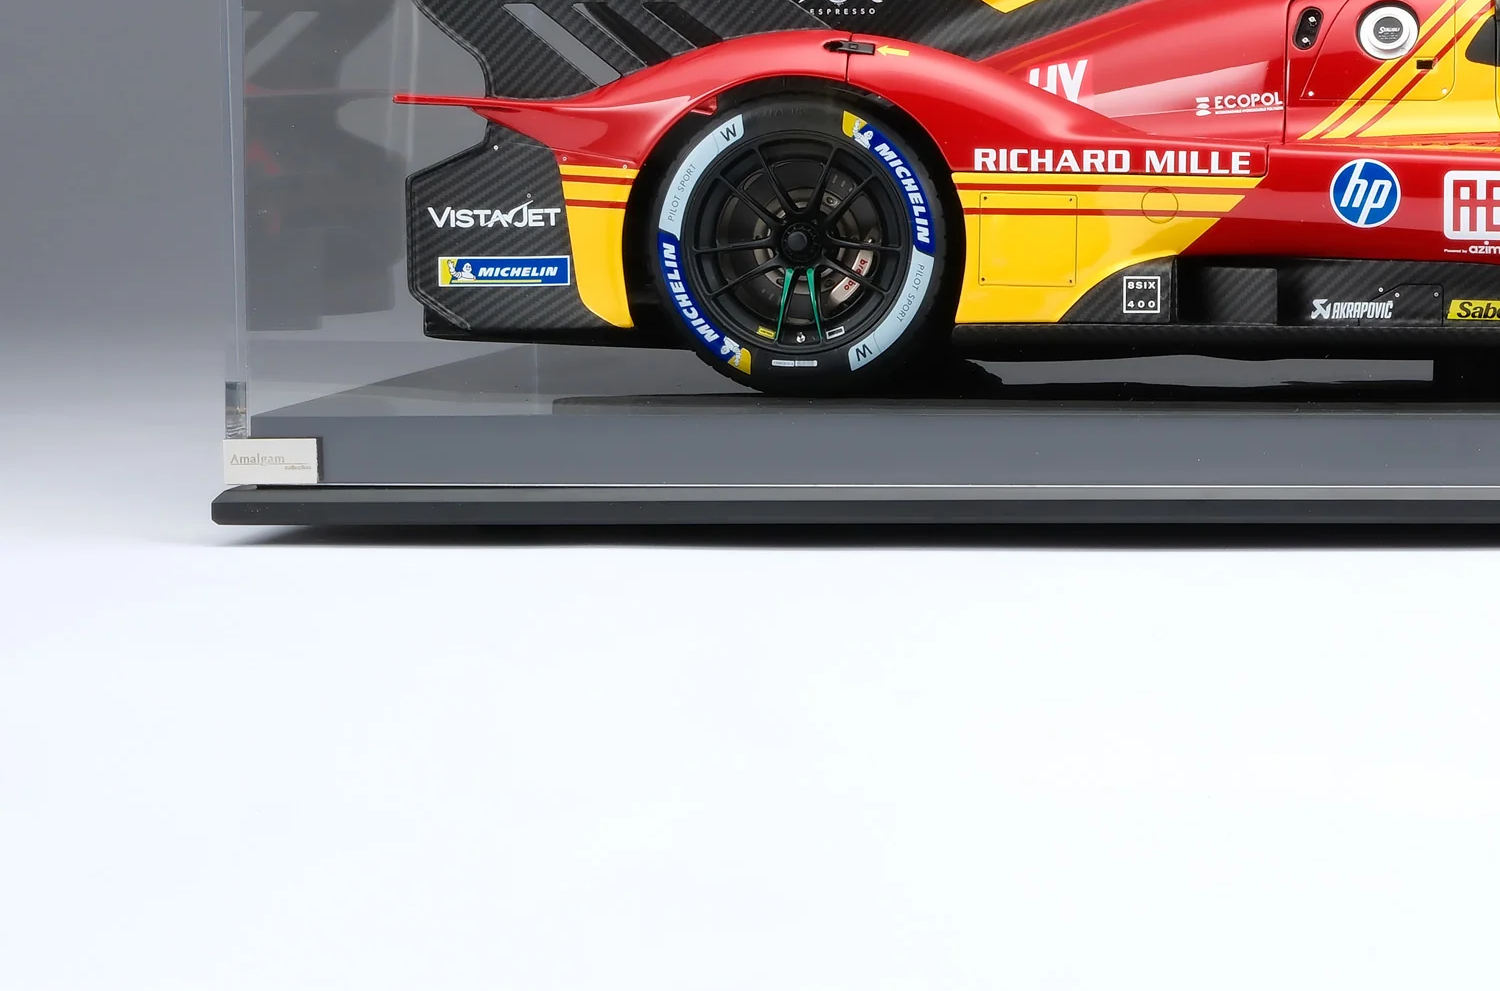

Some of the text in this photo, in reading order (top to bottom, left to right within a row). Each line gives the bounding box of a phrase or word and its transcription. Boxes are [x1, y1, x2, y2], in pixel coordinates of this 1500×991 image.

[1215, 92, 1283, 109] ECOPOL
[720, 123, 737, 142] W
[974, 148, 1251, 175] RICHARD MILLE
[668, 163, 696, 222] PILOT SPORT
[875, 142, 931, 244] MICHELIN
[1340, 161, 1391, 225] hp
[478, 266, 558, 277] MICHELIN
[663, 242, 719, 342] MICHELIN
[896, 263, 925, 322] PILOT SPORT
[1127, 281, 1156, 289] 8SIX
[855, 343, 873, 362] W
[230, 453, 285, 466] Amalgam
